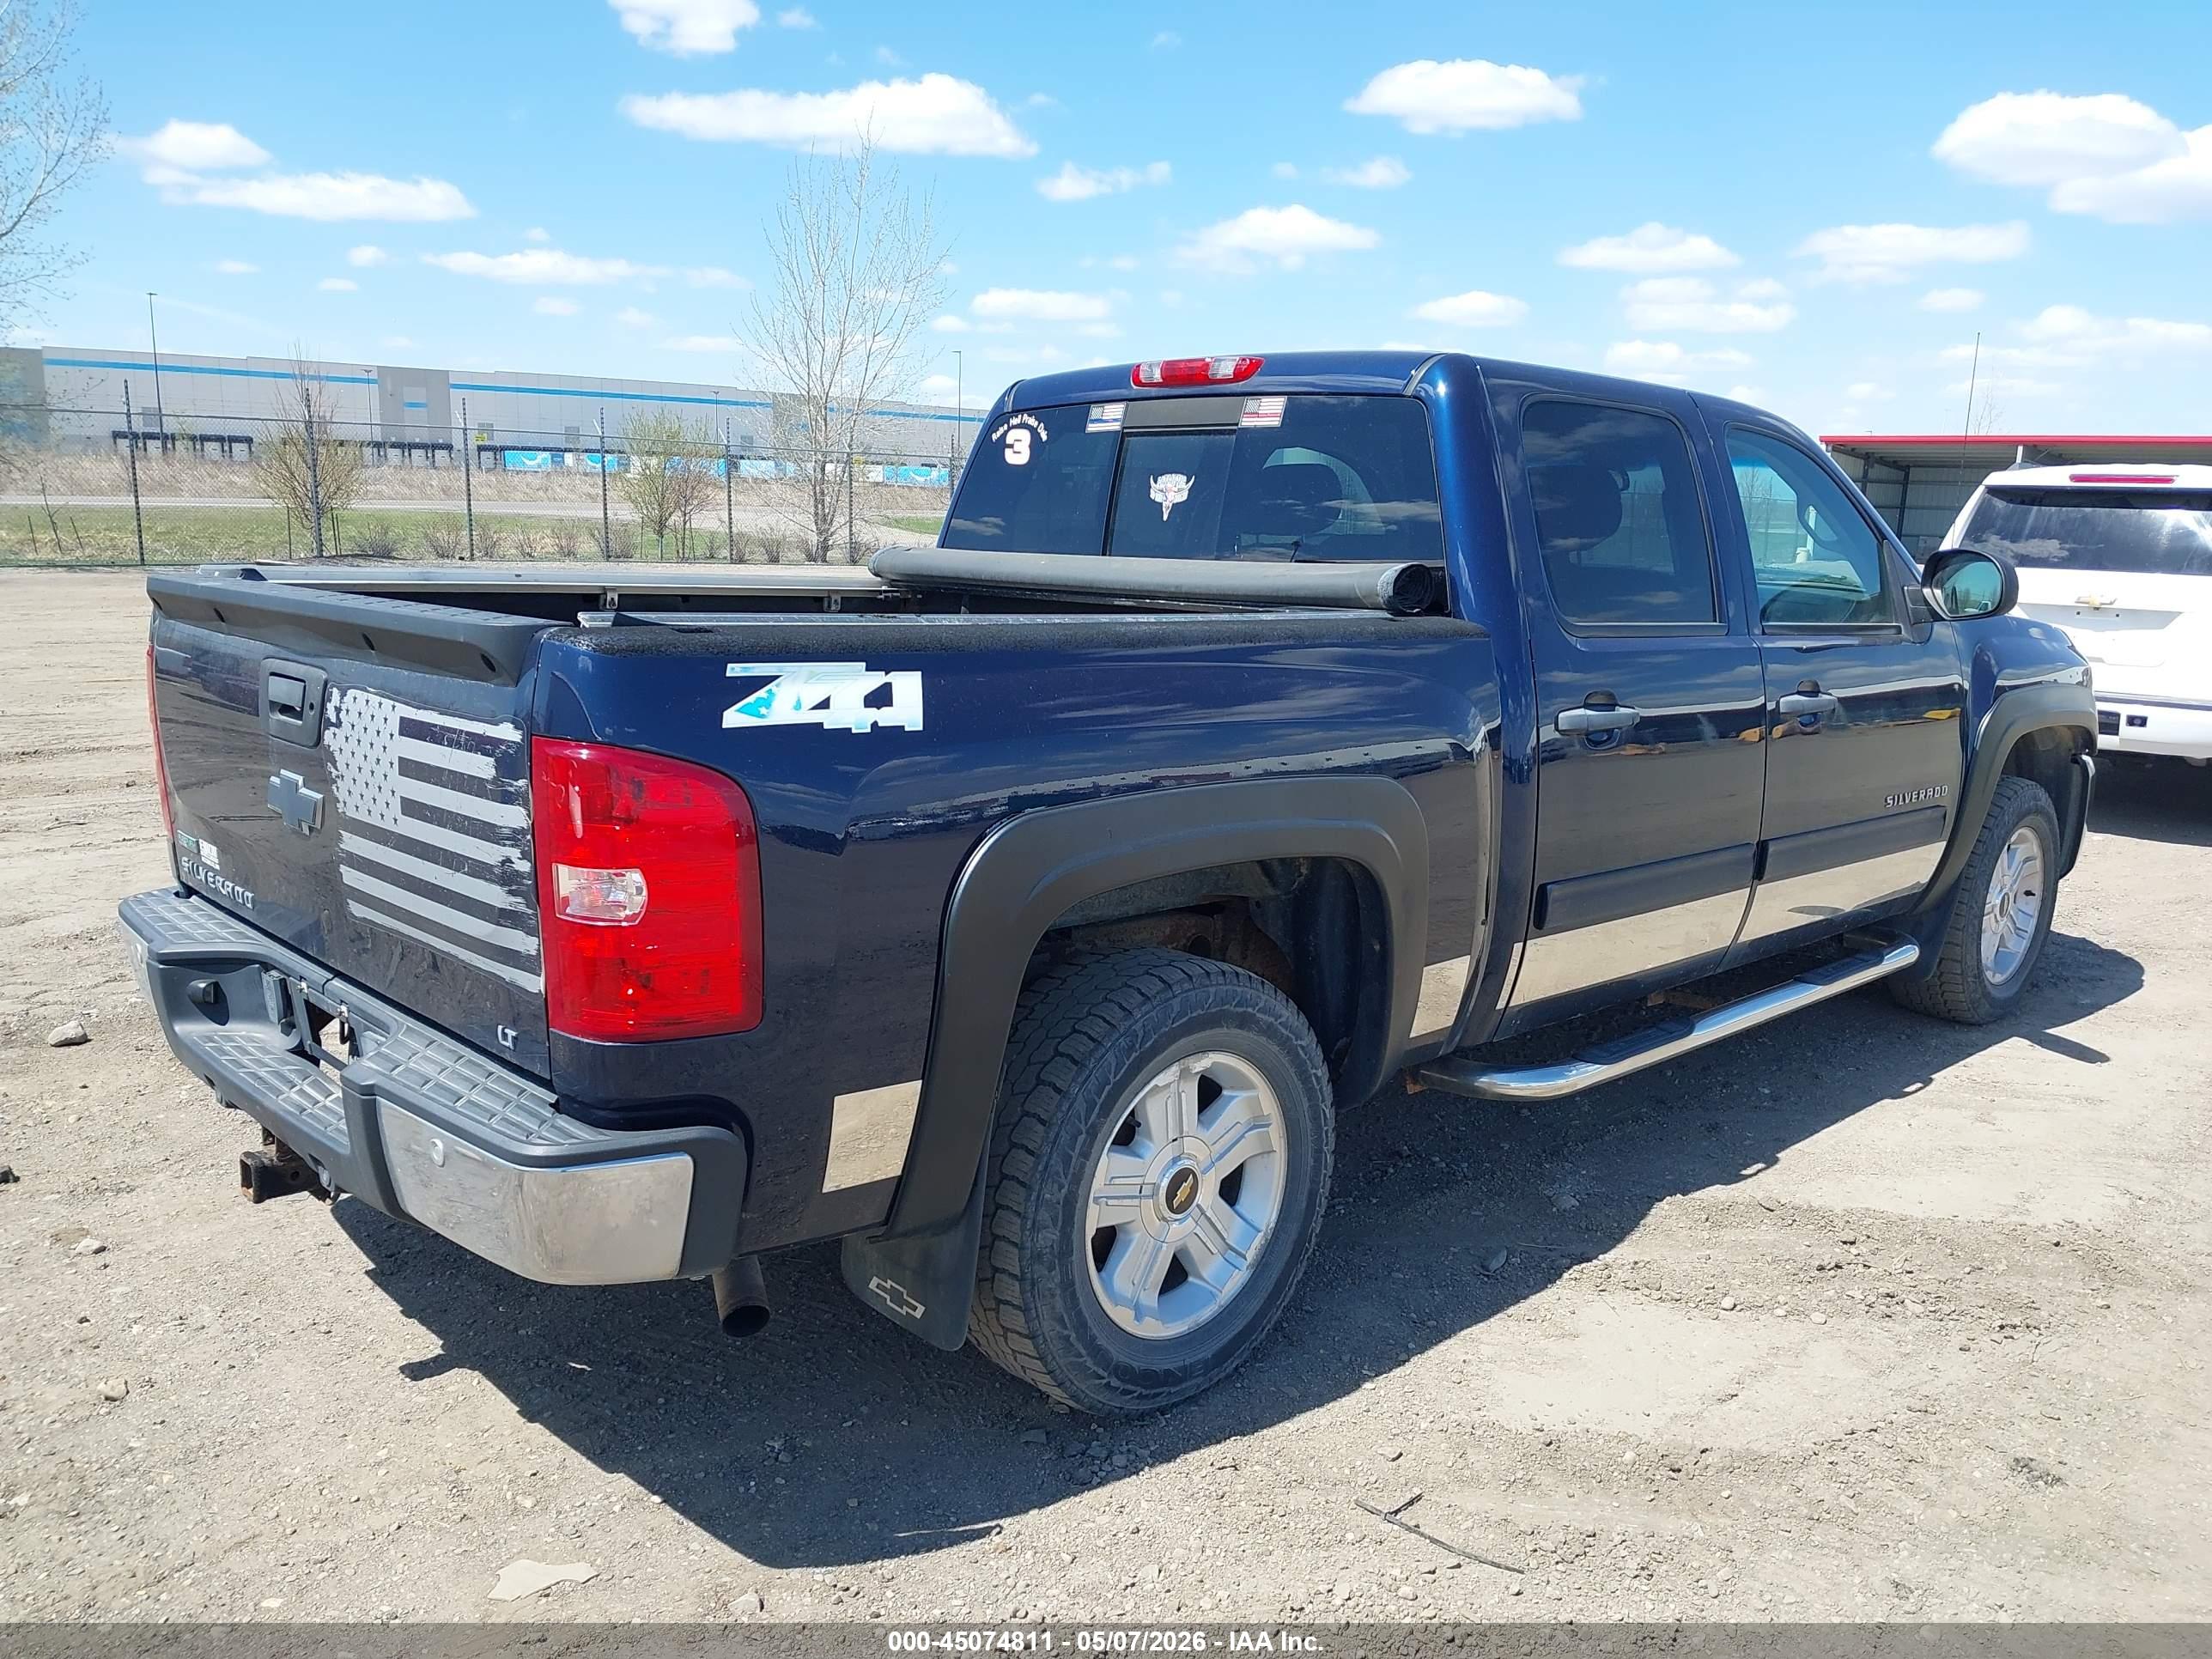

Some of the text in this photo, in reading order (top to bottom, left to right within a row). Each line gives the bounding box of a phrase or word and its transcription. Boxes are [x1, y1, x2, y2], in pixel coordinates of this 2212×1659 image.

[1004, 428, 1031, 465] 3
[1886, 785, 1948, 808] SILVERADO
[181, 856, 255, 910] SILVERADO
[496, 1024, 518, 1050] LT
